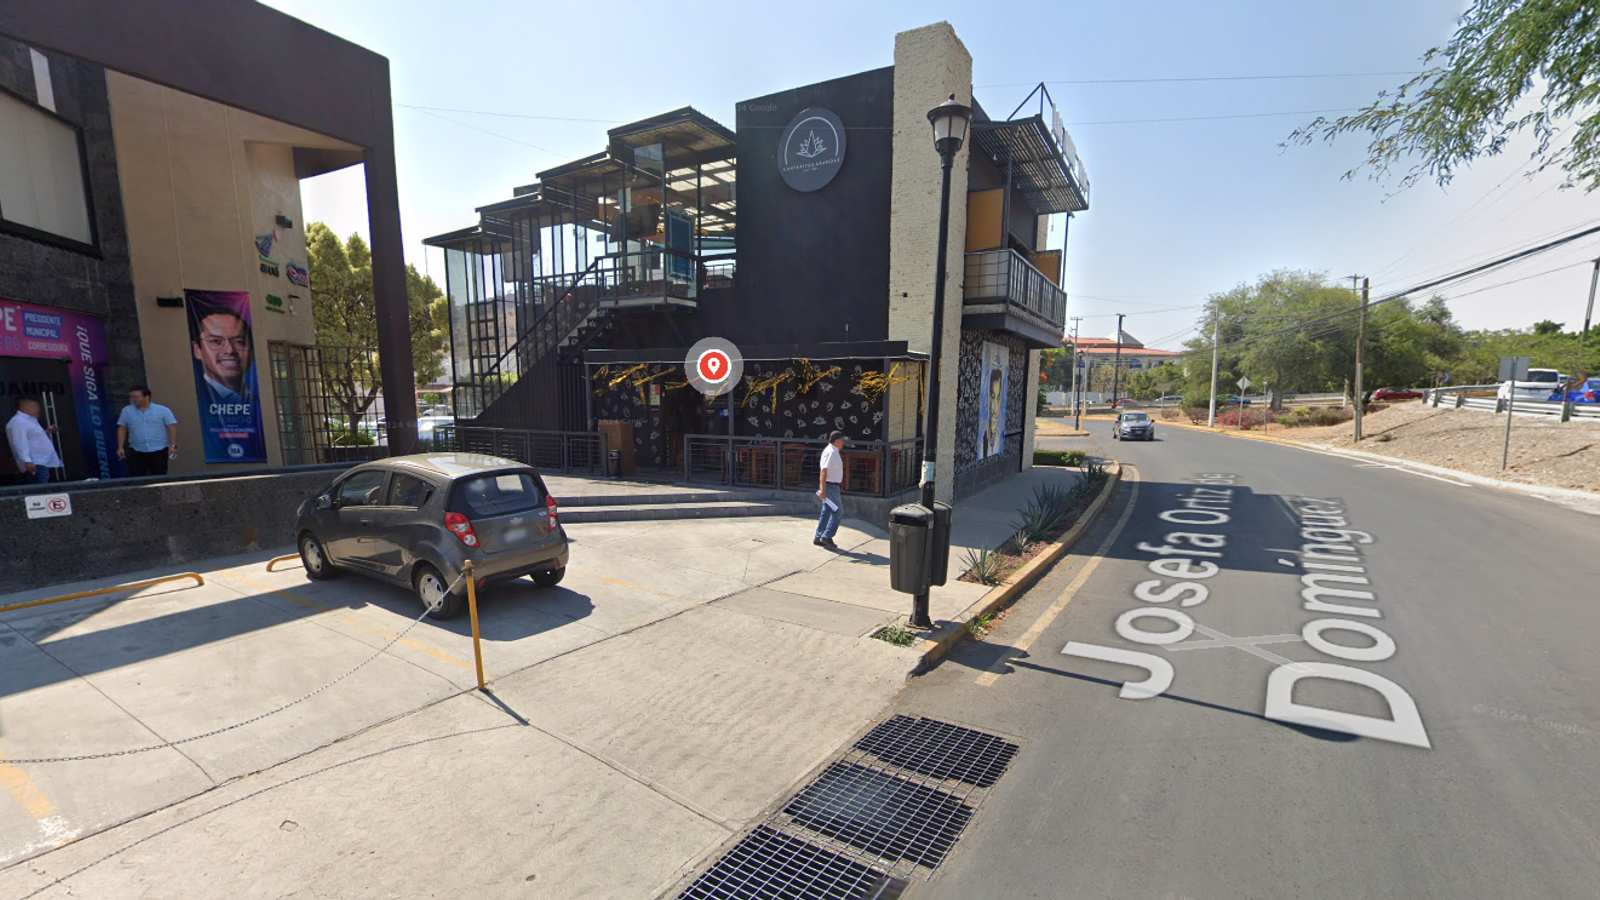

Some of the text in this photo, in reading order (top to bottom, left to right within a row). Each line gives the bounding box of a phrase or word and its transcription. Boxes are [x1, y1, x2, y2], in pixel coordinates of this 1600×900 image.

[24, 312, 62, 326] PRESIDENTE
[26, 326, 59, 338] MUNICIPAL
[28, 341, 69, 353] CORREGIDORA
[83, 366, 98, 400] SIGA
[90, 404, 102, 426] LO
[209, 403, 251, 416] CHEPE
